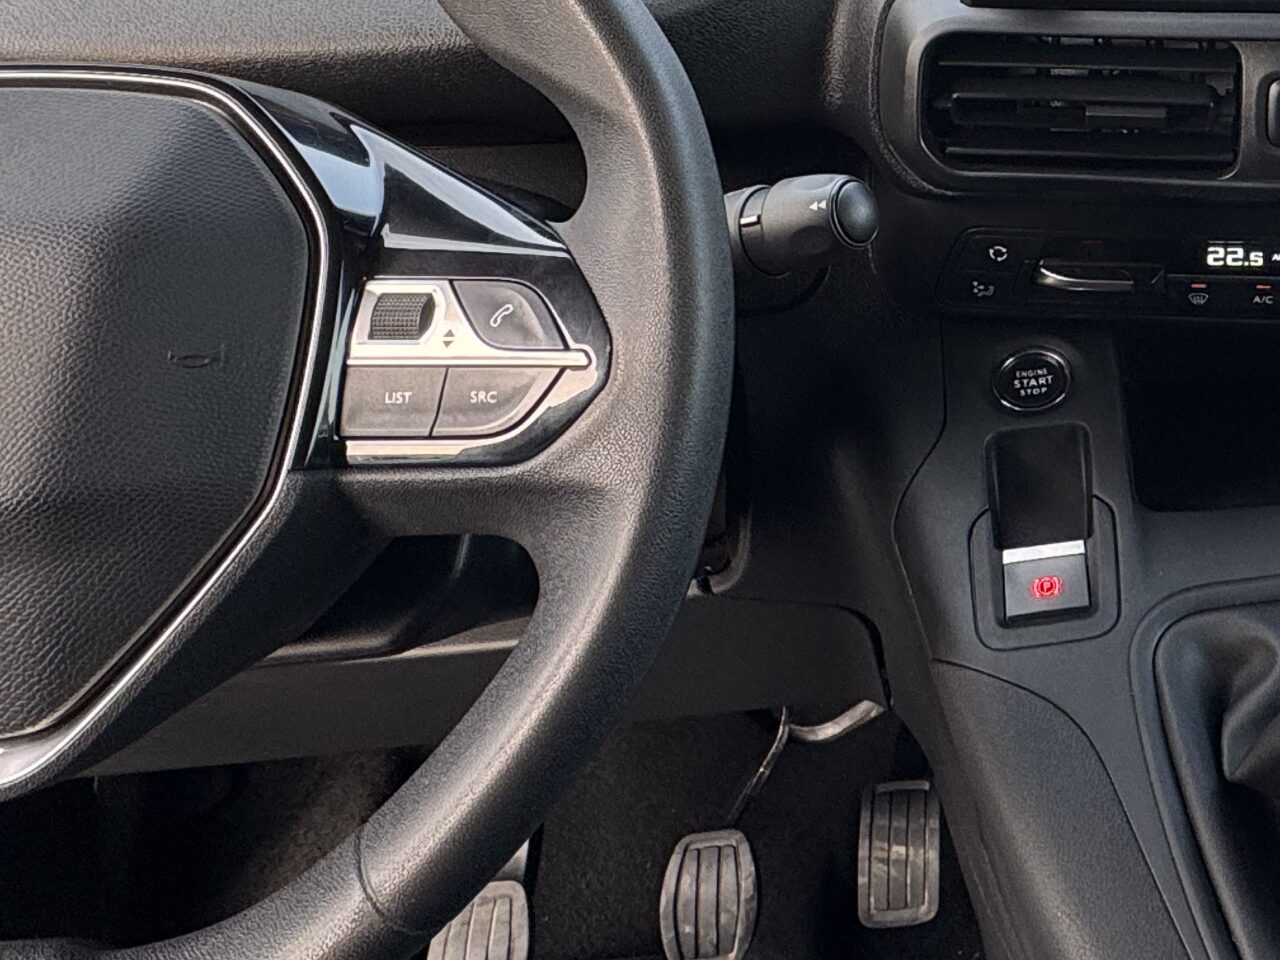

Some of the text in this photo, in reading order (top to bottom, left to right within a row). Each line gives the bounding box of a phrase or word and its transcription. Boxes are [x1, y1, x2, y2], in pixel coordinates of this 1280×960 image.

[1206, 246, 1264, 267] 22.5
[1253, 295, 1275, 305] A/C
[1015, 368, 1049, 379] ENGINE
[1013, 377, 1054, 390] START
[385, 391, 498, 404] LIST SRC
[1019, 388, 1048, 398] STOP
